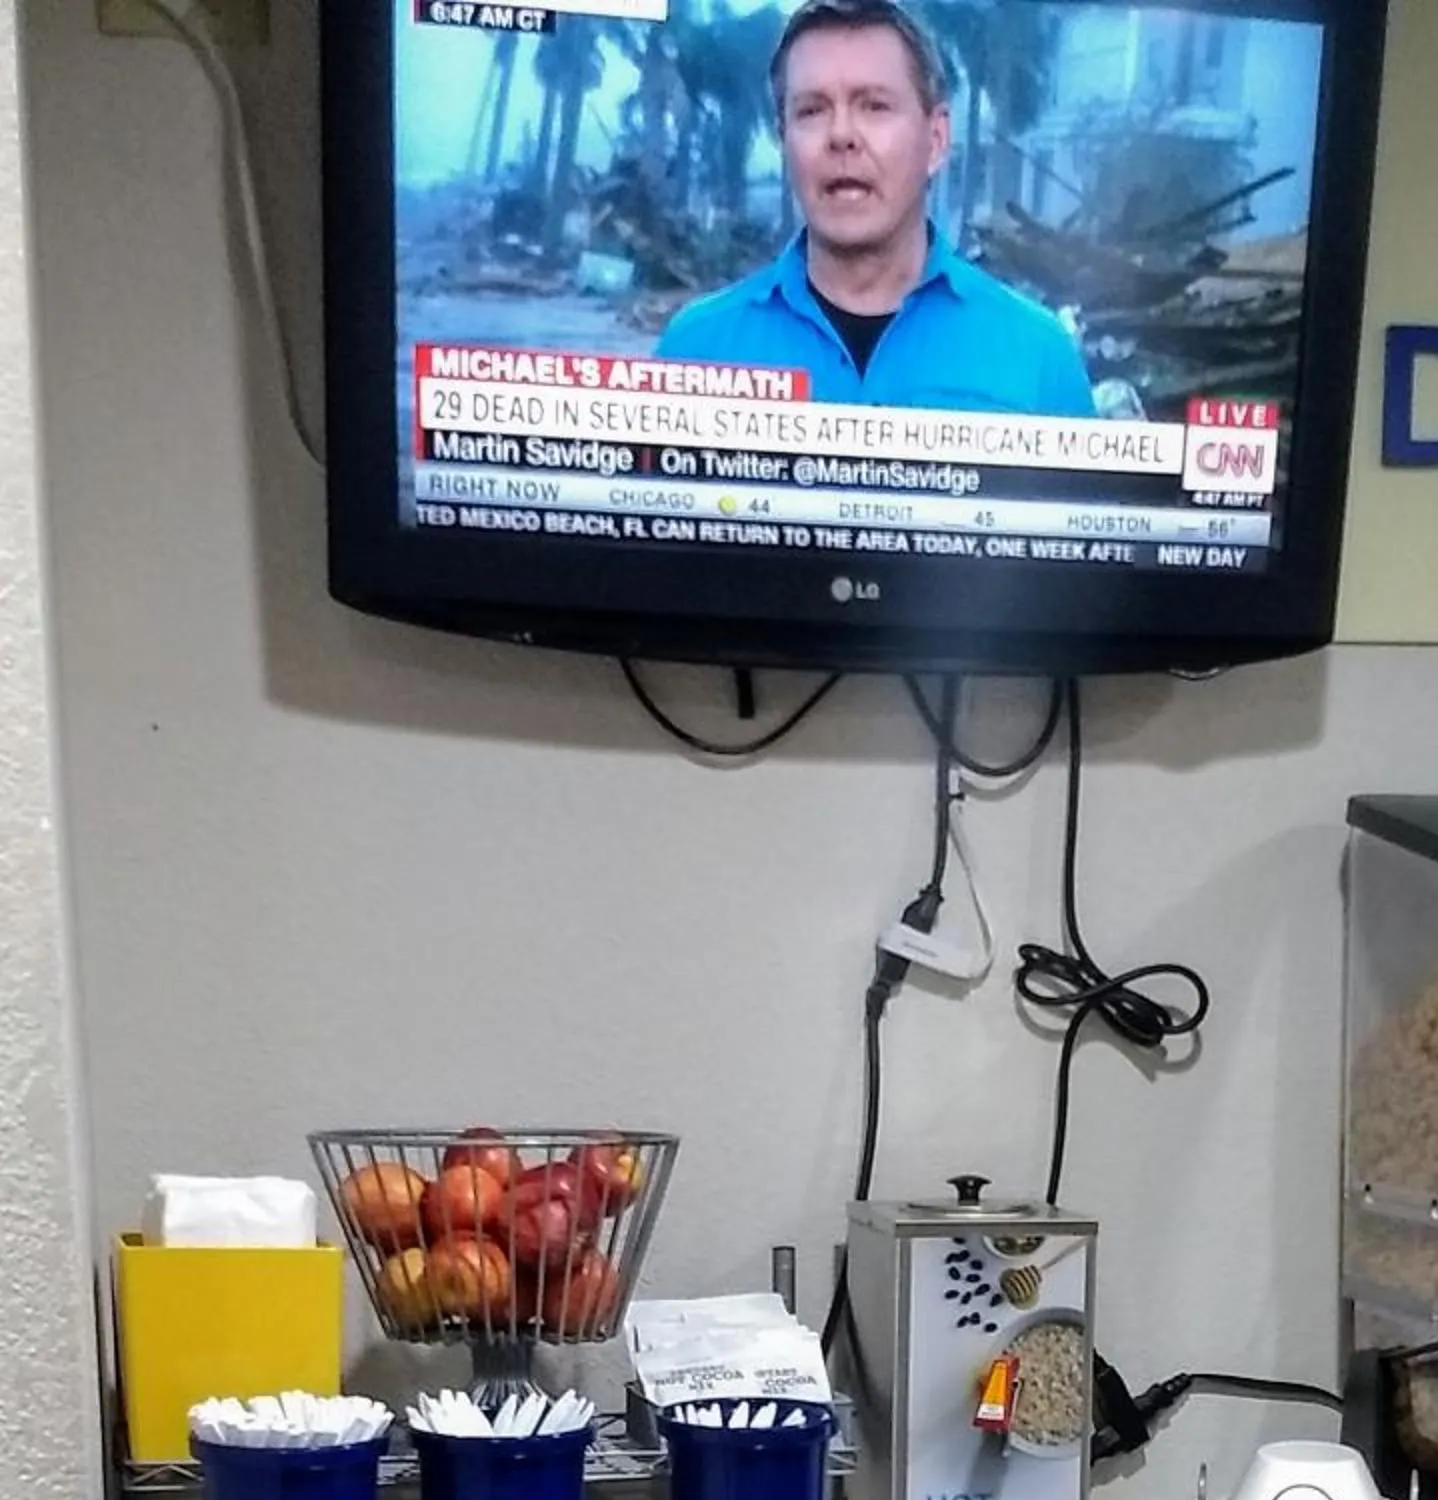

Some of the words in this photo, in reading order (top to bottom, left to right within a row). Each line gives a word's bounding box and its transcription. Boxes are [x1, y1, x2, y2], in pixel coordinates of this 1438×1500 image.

[430, 2, 474, 25] 6:47
[479, 6, 513, 29] AM
[516, 10, 546, 31] CT
[431, 347, 600, 387] MICHAEL'S
[608, 361, 793, 400] AFTERMATH
[433, 389, 462, 420] 29
[473, 393, 545, 425] DEAD
[555, 400, 579, 426] IN
[590, 401, 702, 436] SEVERAL
[714, 410, 808, 442] STATES
[817, 418, 894, 447] AFTER
[904, 423, 1048, 457] HURRICANE
[1057, 431, 1165, 463] MICHAEL
[1199, 401, 1267, 427] LIVE
[433, 432, 520, 463] Martin
[525, 436, 634, 475] Savidge
[661, 448, 697, 474] On
[701, 451, 789, 481] Twitter:
[793, 455, 981, 494] @MartinSavidge
[1195, 442, 1265, 480] CNN
[430, 474, 498, 499] RIGHT
[506, 480, 561, 502] NOW
[609, 488, 696, 510] CHICAGO
[750, 498, 771, 514] 44
[1223, 492, 1246, 507] AM
[838, 501, 914, 521] DETROIT
[1066, 514, 1152, 534] HOUSTON
[416, 506, 457, 526] TED
[460, 508, 541, 532] MEXICO
[544, 512, 621, 539] BEACH,
[623, 516, 648, 539] FL
[651, 519, 696, 541] CAN
[699, 522, 779, 545] RETURN
[783, 527, 811, 547] TO
[814, 528, 852, 549] THE
[855, 531, 910, 552] AREA
[913, 535, 983, 559] TODAY,
[985, 539, 1027, 558] ONE
[1031, 541, 1086, 561] WEEK
[1157, 544, 1205, 567] NEW
[1206, 547, 1247, 569] DAY
[855, 581, 880, 600] LG
[692, 1369, 745, 1382] COCOA
[765, 1375, 817, 1387] COCOA
